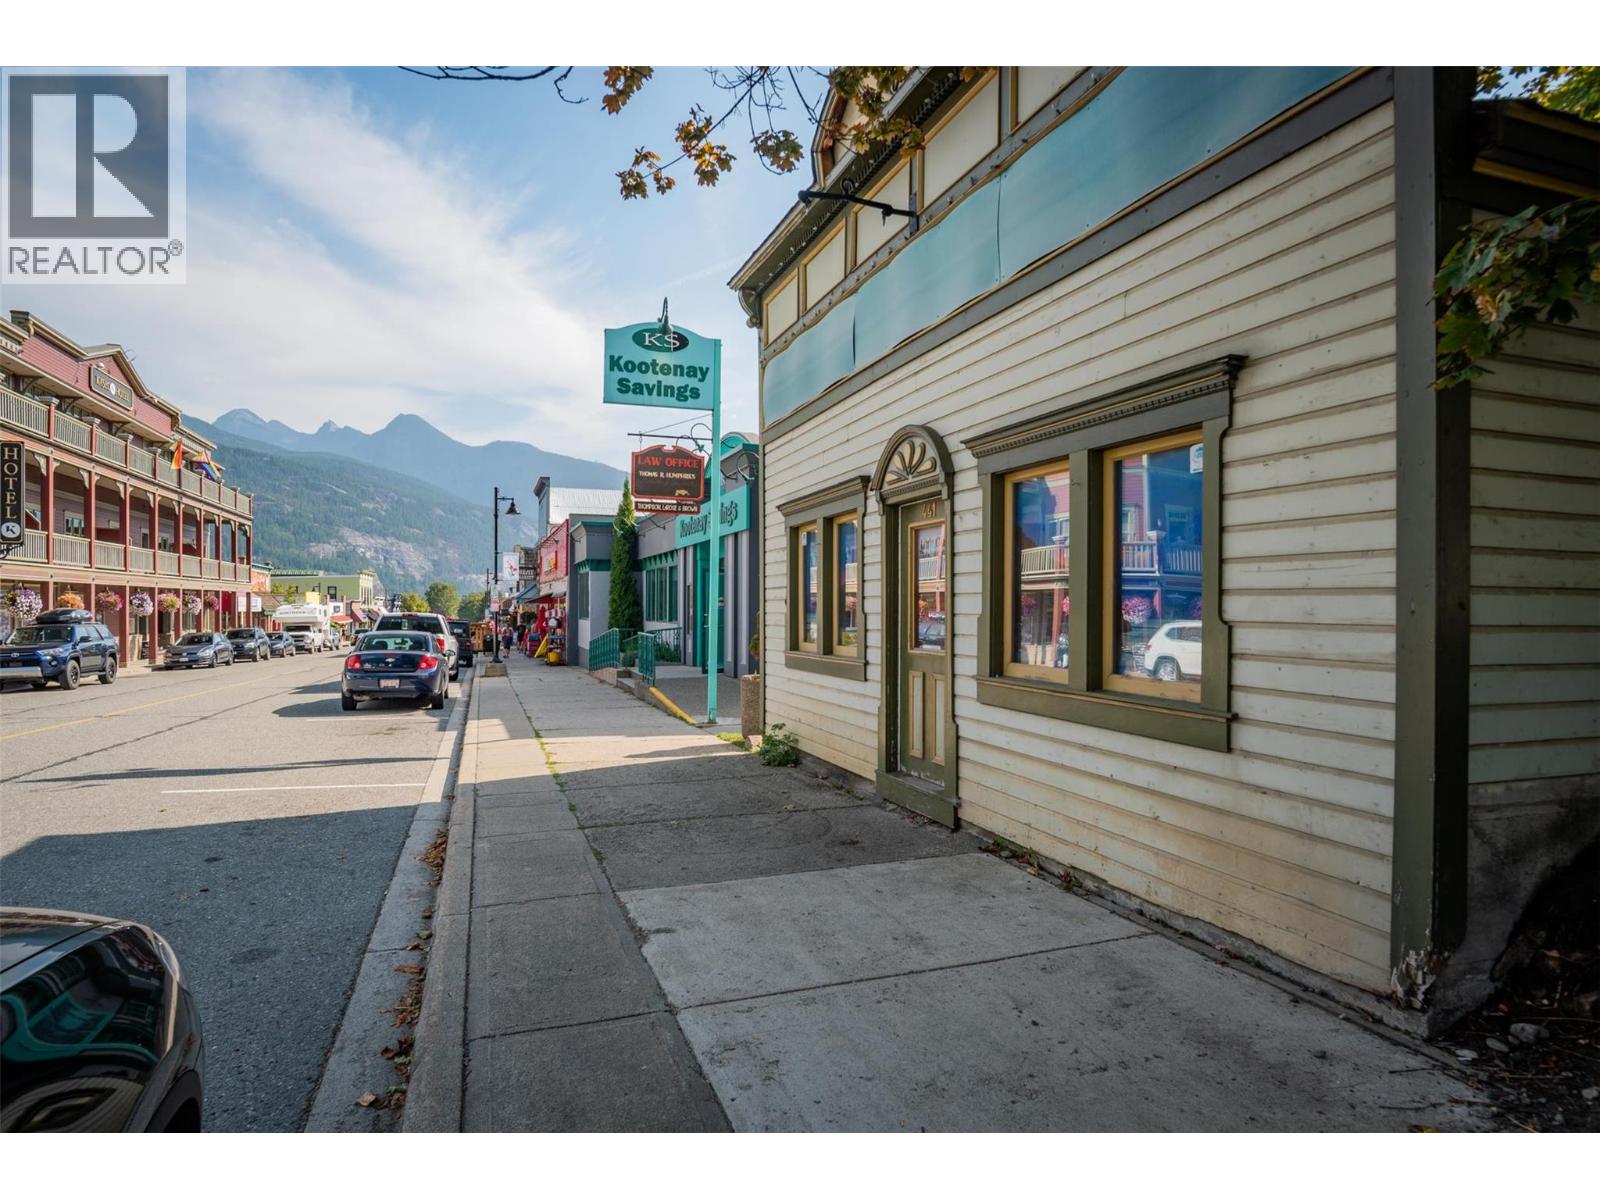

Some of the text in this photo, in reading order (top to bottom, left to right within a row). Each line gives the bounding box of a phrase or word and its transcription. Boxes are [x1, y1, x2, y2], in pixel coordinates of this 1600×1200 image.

[609, 355, 710, 382] Kootenay
[617, 378, 701, 402] Savings
[638, 455, 699, 468] LAW OFFICE
[3, 447, 18, 519] HOTEL
[639, 470, 658, 478] THOMAS
[680, 514, 707, 538] Kootenay
